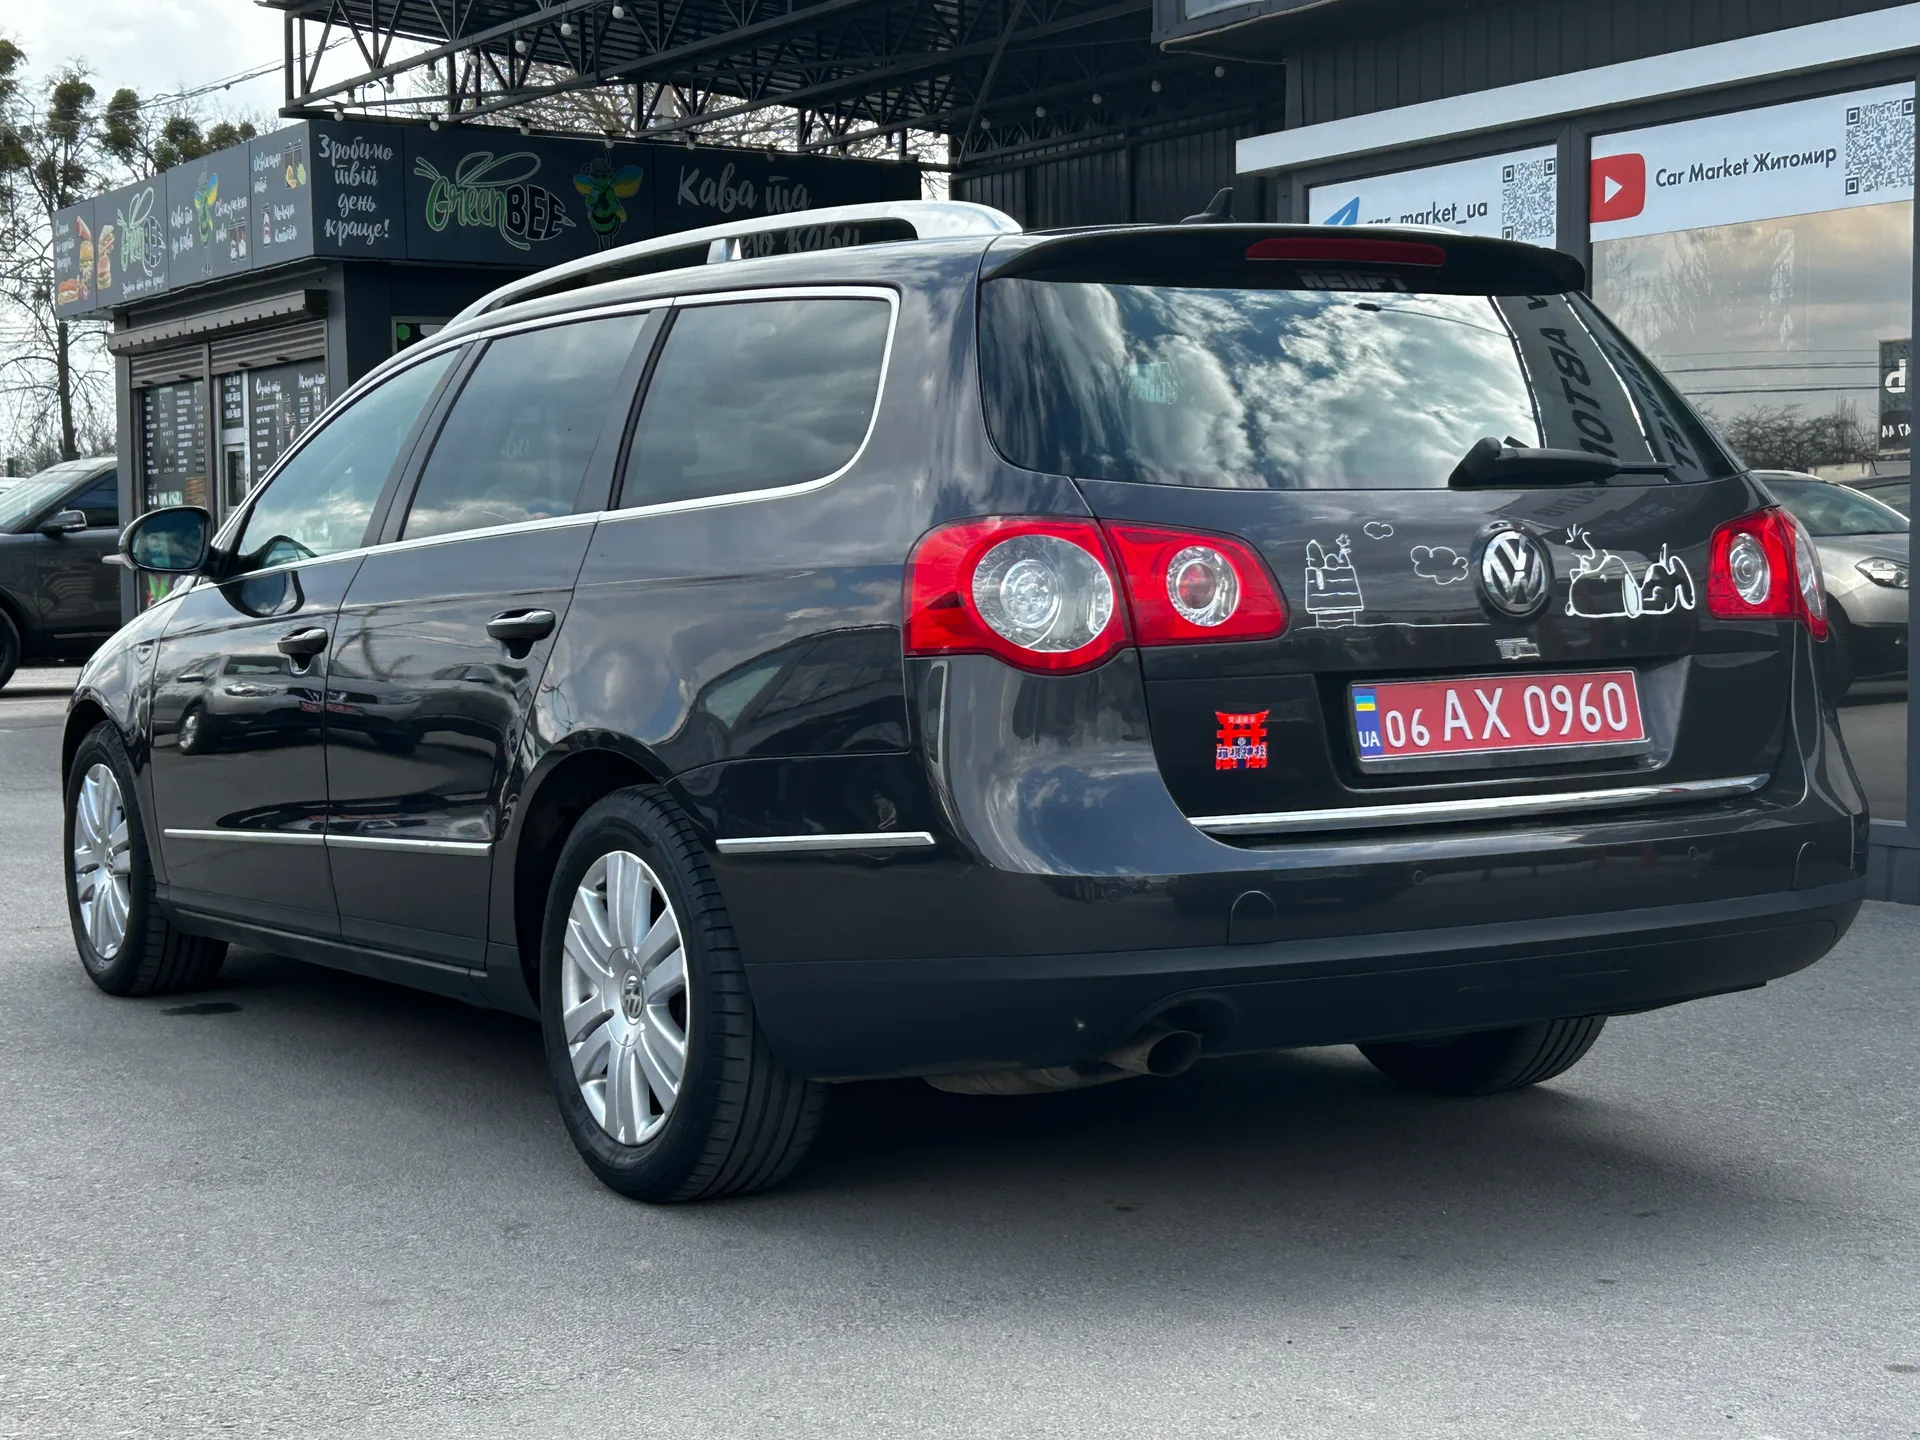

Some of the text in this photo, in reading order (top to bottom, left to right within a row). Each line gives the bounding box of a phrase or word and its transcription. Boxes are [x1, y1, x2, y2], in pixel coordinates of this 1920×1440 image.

[318, 133, 393, 167] Зробимо
[334, 160, 378, 187] твій
[1655, 147, 1837, 187] Car Market Житомир
[677, 162, 812, 213] Кава та
[337, 193, 377, 218] день
[323, 218, 390, 247] краще!
[1385, 681, 1629, 748] 06 AX 0960
[1358, 730, 1381, 748] UA
